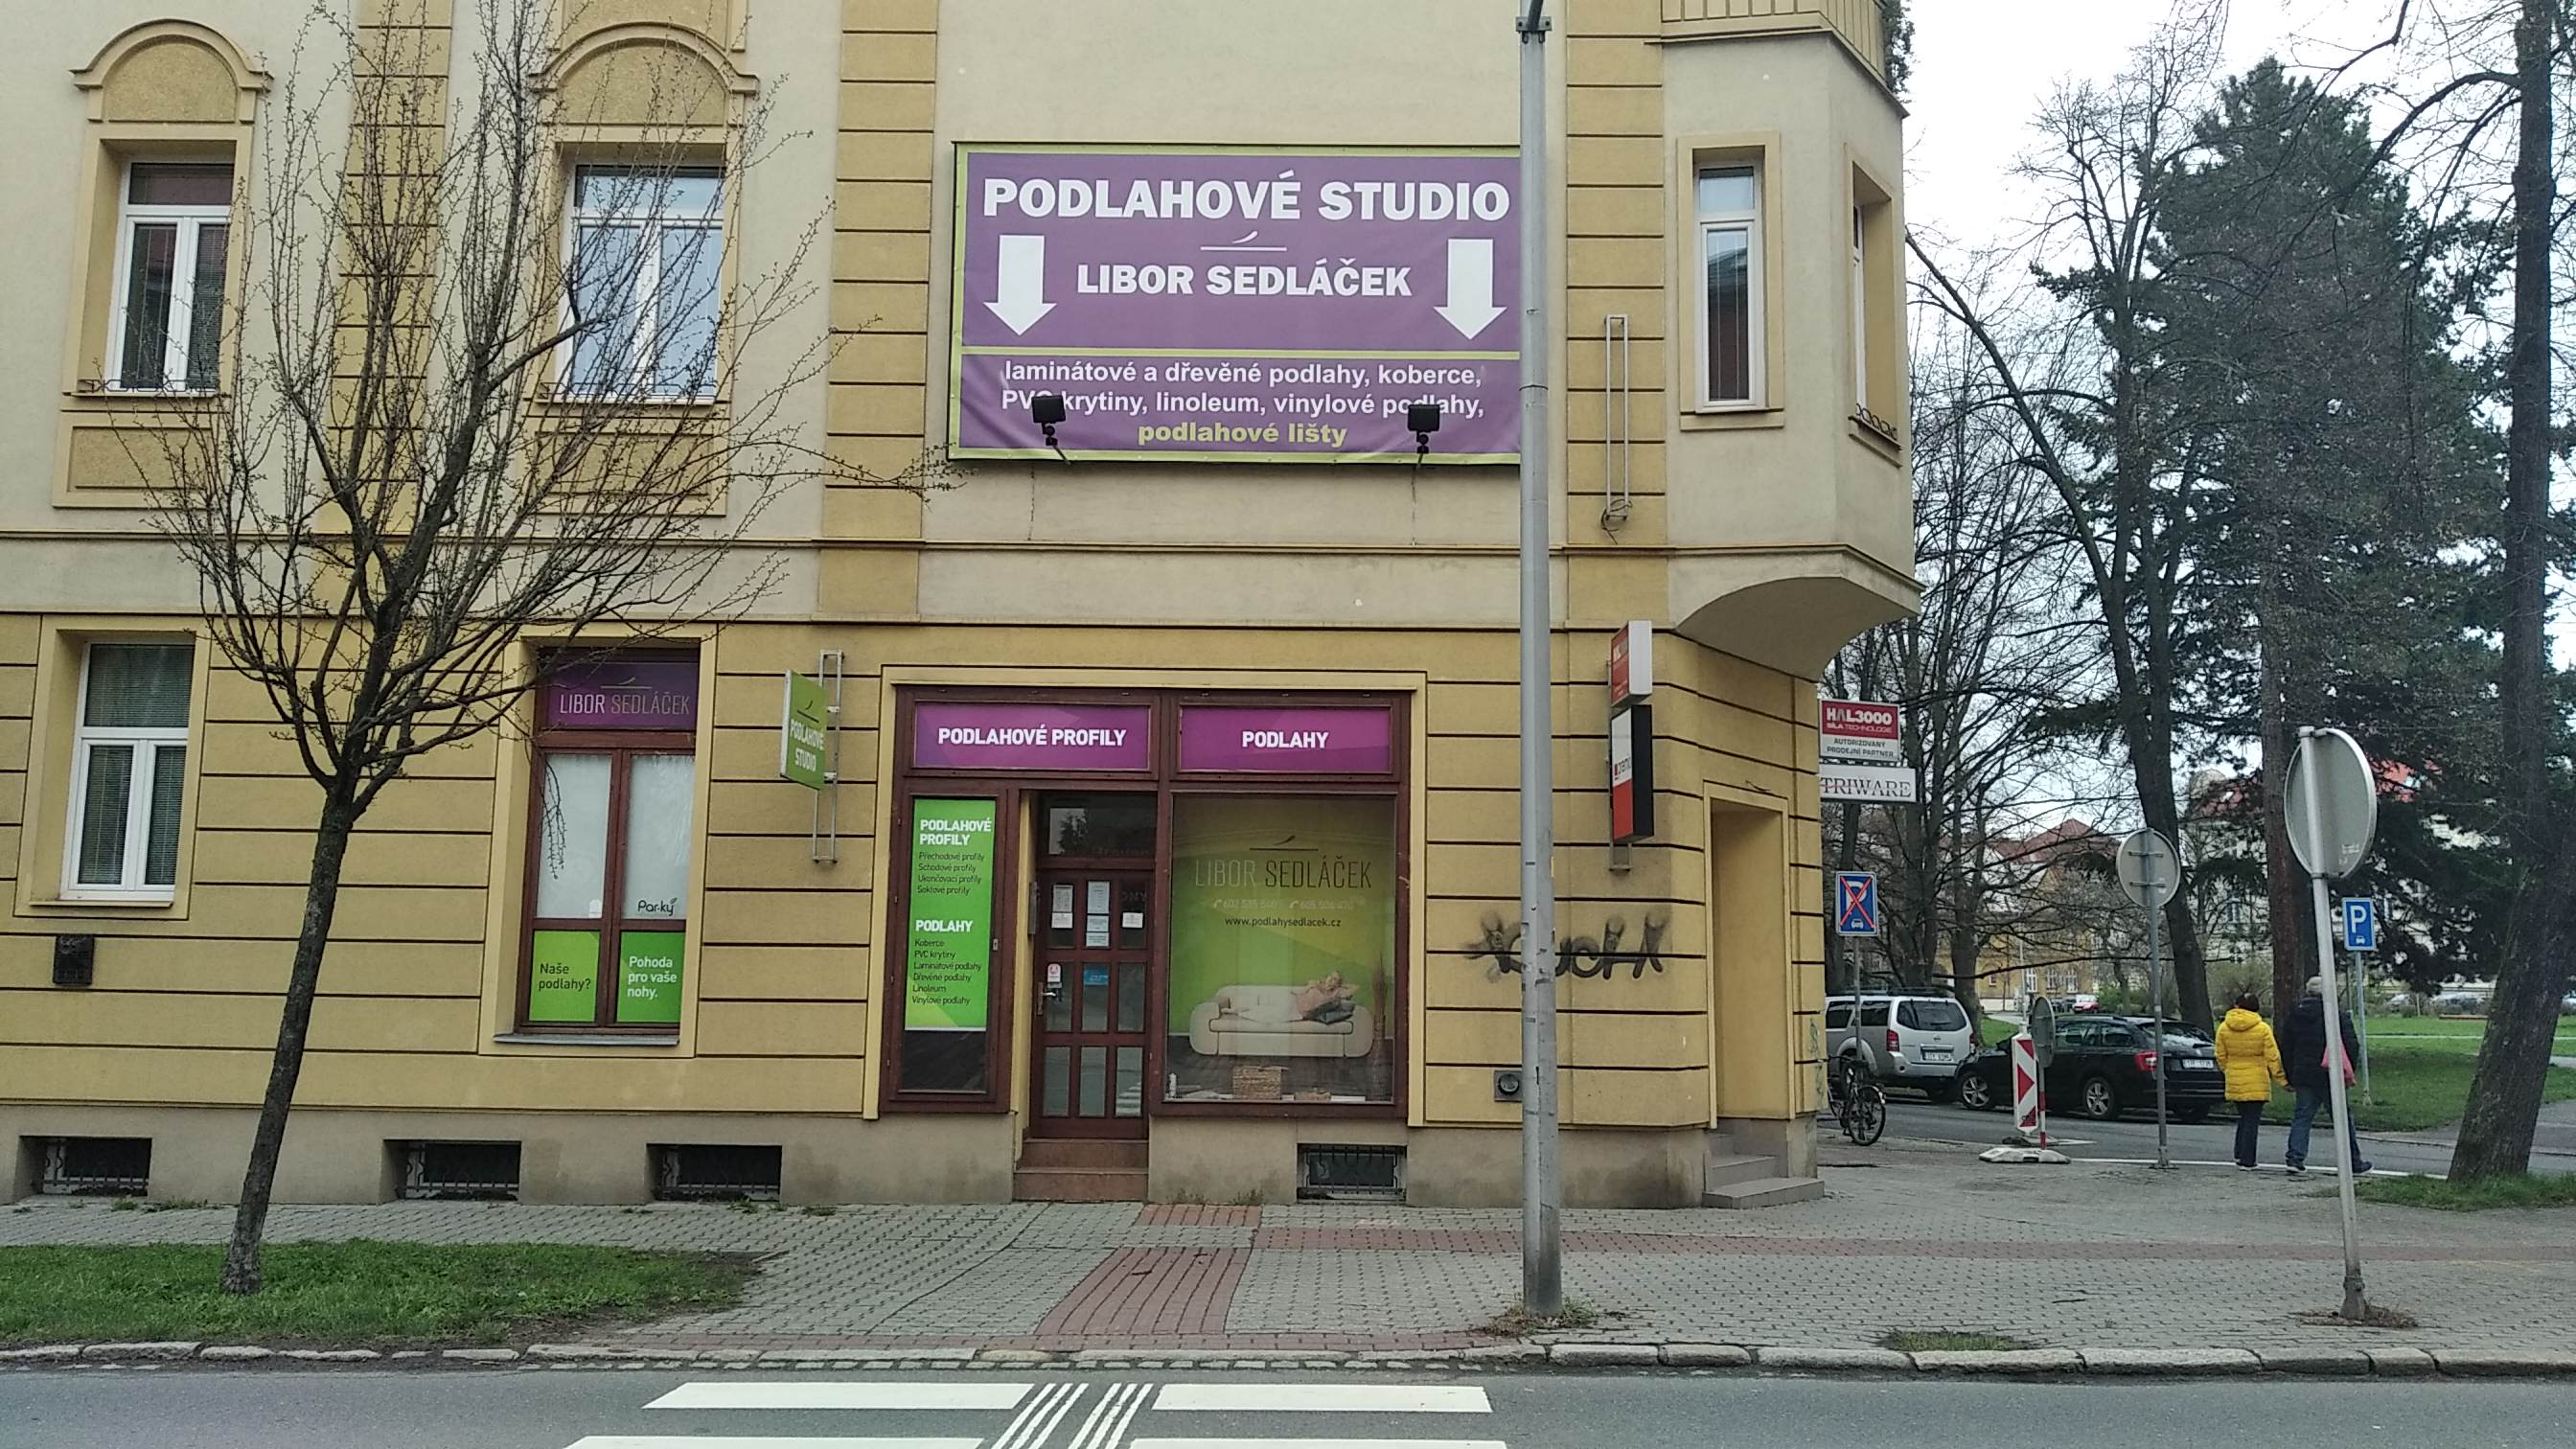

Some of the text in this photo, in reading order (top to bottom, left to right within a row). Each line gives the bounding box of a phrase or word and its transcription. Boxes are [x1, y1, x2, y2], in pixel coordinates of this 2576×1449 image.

[983, 170, 1510, 221] PODLAHOVÉ STUDIO
[1077, 257, 1413, 296] LIBOR SEDLÁČEK
[1005, 360, 1482, 388] laminátové a dřevěné podlahy, koberce,
[1001, 390, 1053, 410] PV
[1061, 391, 1148, 415] krytiny,
[1156, 391, 1266, 415] linoleum,
[1273, 393, 1375, 418] vinylové
[1138, 422, 1347, 448] podlahové lišty
[560, 690, 690, 715] LIBOR SEDLÁČEK
[1827, 707, 1893, 725] HAL3000
[790, 719, 824, 751] PODLAHOVÉ
[938, 724, 1127, 747] PODLAHOVÉ PROFILY
[1242, 730, 1329, 748] PODLAHY
[795, 748, 816, 772] STUDIO
[1862, 748, 1894, 758] PARTNER
[1821, 776, 1912, 798] TRIWARE
[920, 816, 992, 832] PODLAHOVÉ
[919, 834, 970, 845] PROFILY
[962, 852, 984, 862] profily
[954, 863, 976, 873] profily
[1195, 855, 1371, 888] LIBOR SEDLÁČEK
[959, 875, 981, 885] profily
[947, 886, 970, 896] profily
[915, 919, 974, 932] PODLAHY
[1225, 916, 1342, 929] www.podlahysedlacek.cz
[2350, 905, 2367, 934] P
[629, 955, 673, 968] Pohoda
[931, 950, 955, 960] krytiny
[540, 962, 569, 975] Naše
[954, 962, 981, 972] podlahy
[628, 970, 677, 983] pro vaše
[944, 973, 972, 982] podlahy
[539, 978, 591, 992] podlahy?
[627, 986, 658, 1000] nohy.
[942, 996, 971, 1006] podlahy
